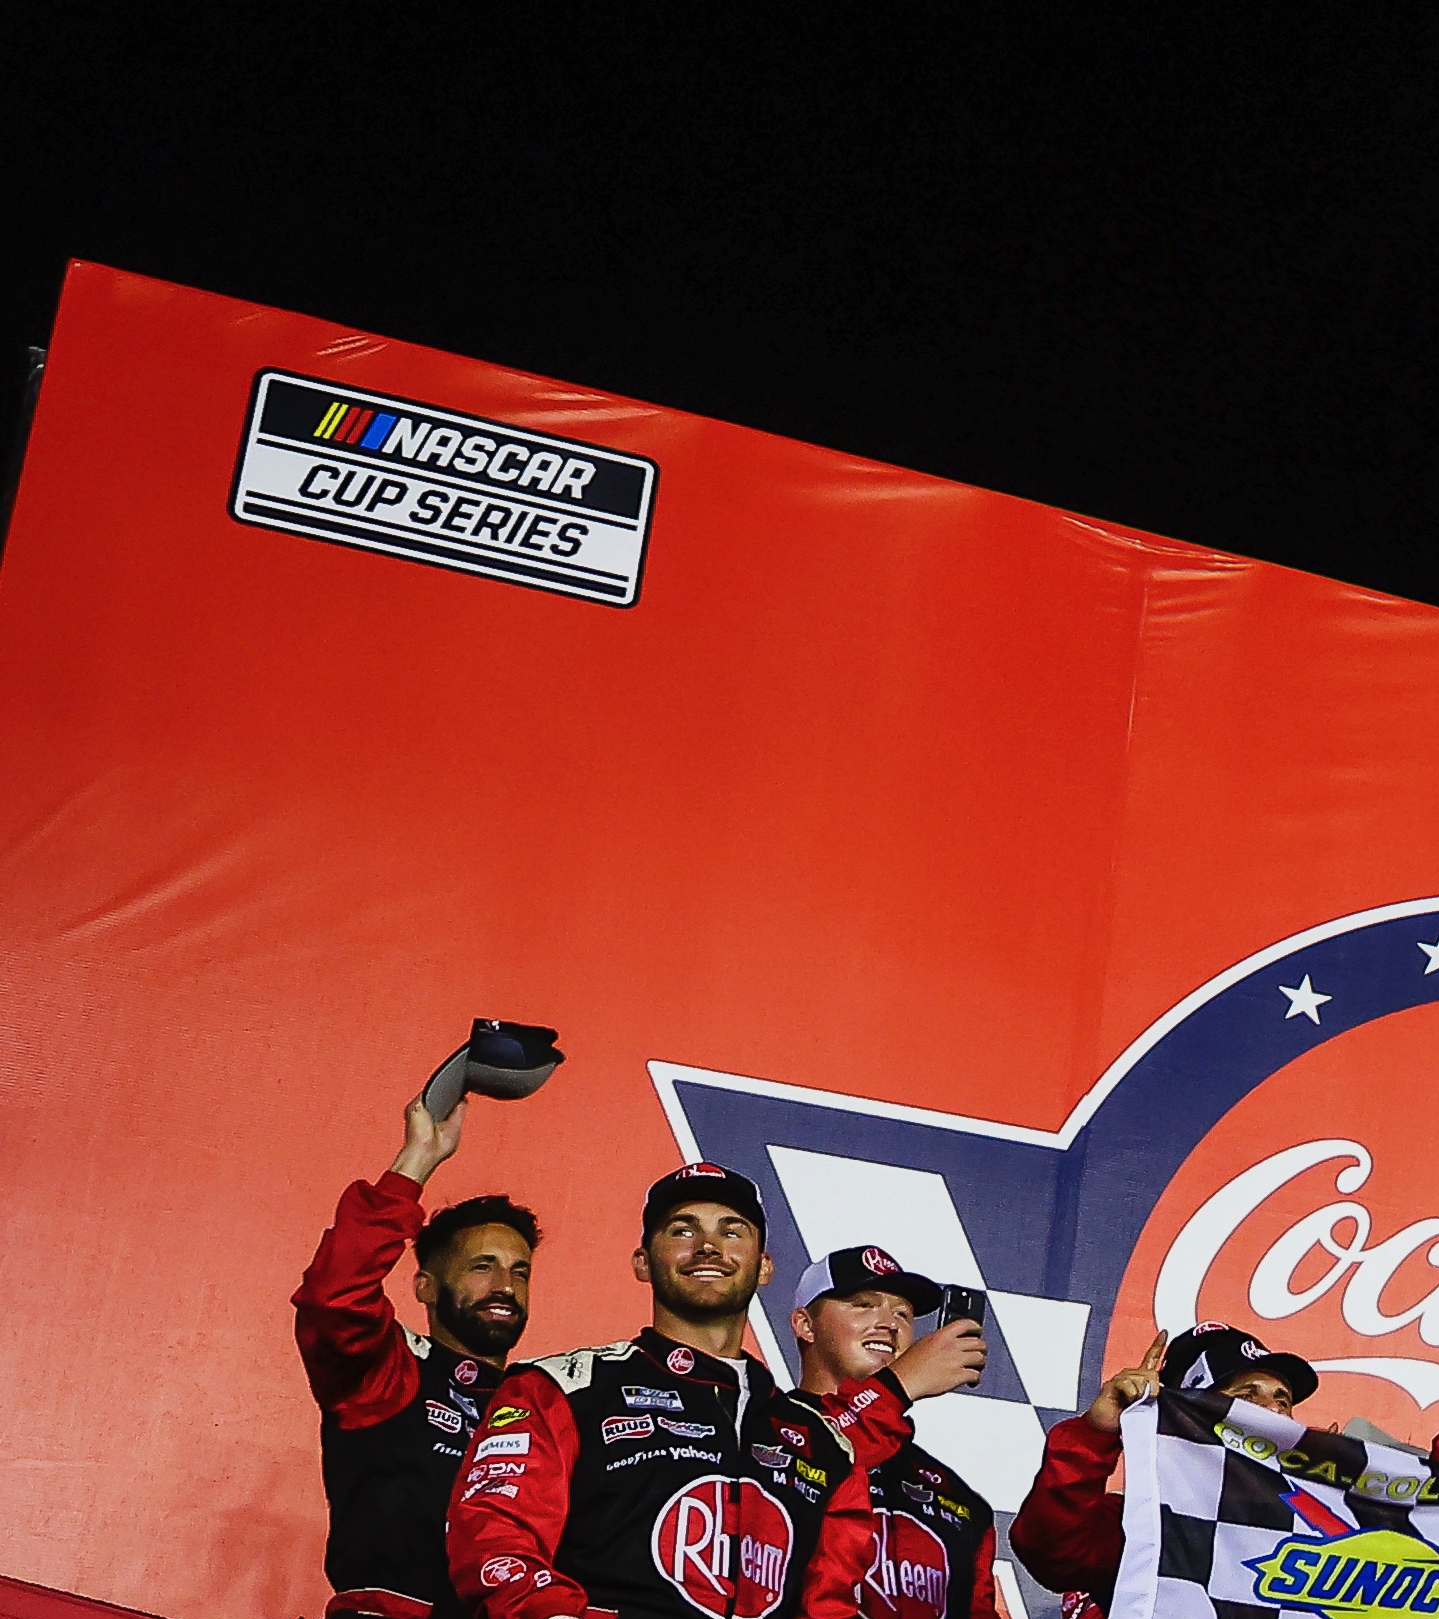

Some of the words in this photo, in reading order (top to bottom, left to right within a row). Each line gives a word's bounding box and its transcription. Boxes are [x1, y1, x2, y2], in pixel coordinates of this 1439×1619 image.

[383, 417, 597, 500] NASCAR
[298, 464, 408, 516] CUP
[409, 491, 590, 558] SERIES
[604, 1420, 652, 1436] RUUD
[669, 1445, 722, 1464] yahoo!
[674, 1481, 783, 1595] Rheem
